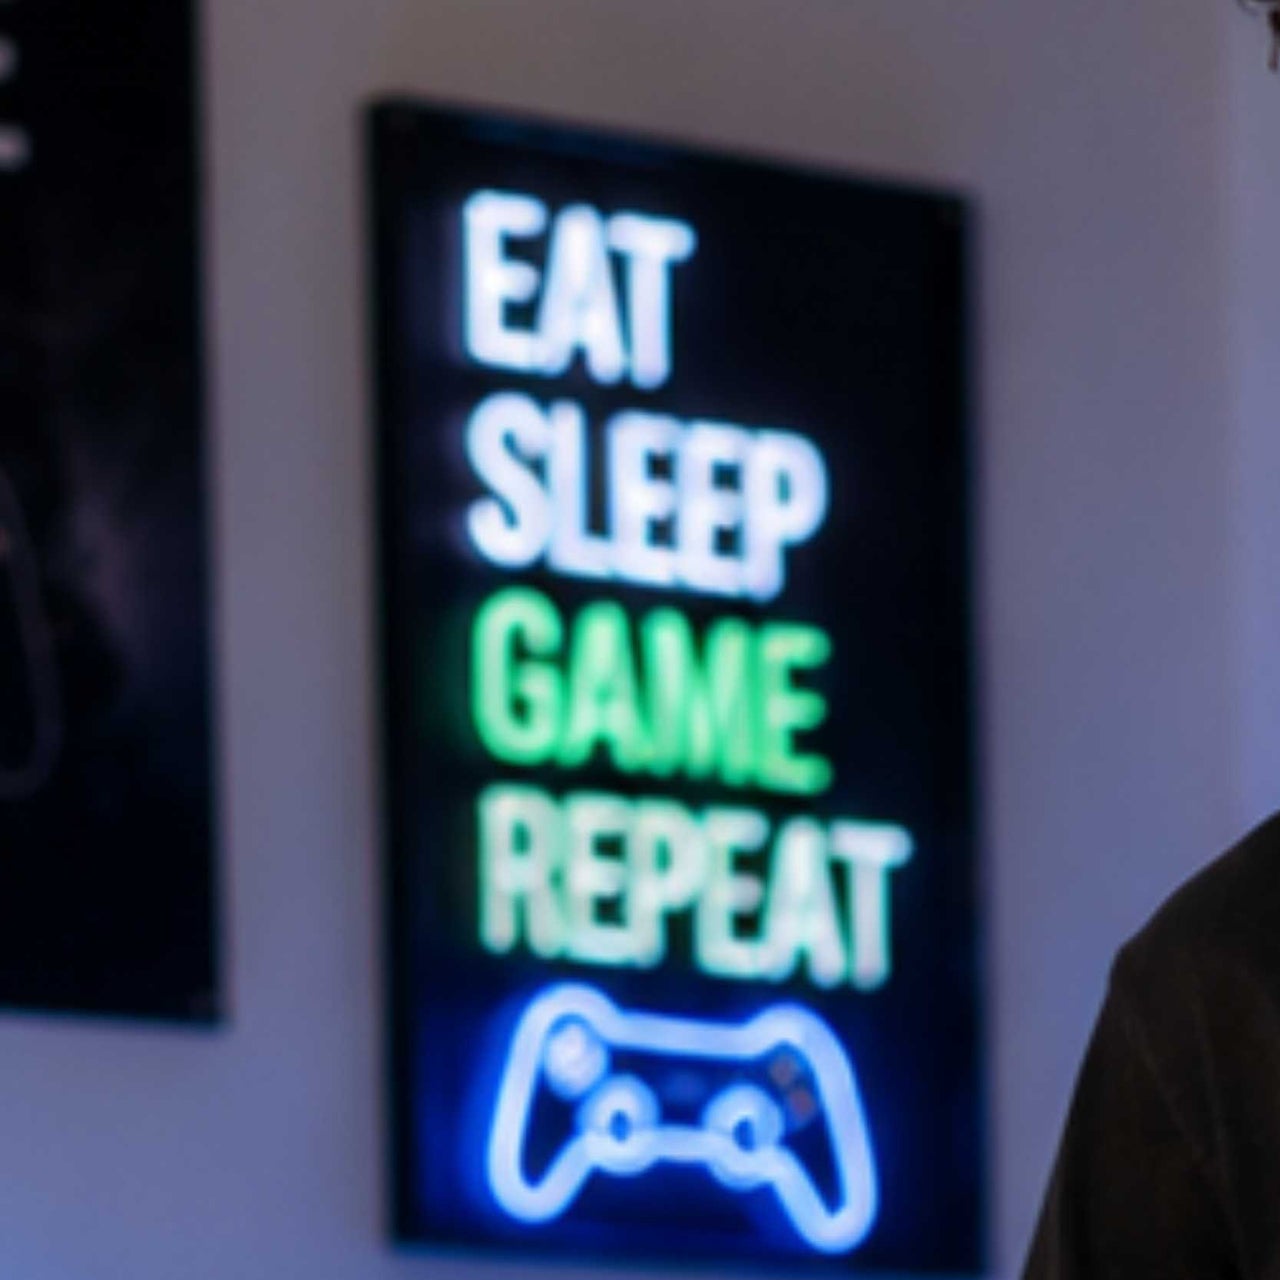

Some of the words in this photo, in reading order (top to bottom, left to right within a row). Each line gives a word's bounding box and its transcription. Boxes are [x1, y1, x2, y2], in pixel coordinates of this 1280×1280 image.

[463, 189, 697, 388] EAT
[465, 392, 829, 603] SLEEP
[471, 586, 832, 795] GAME
[477, 783, 912, 990] REPEAT
